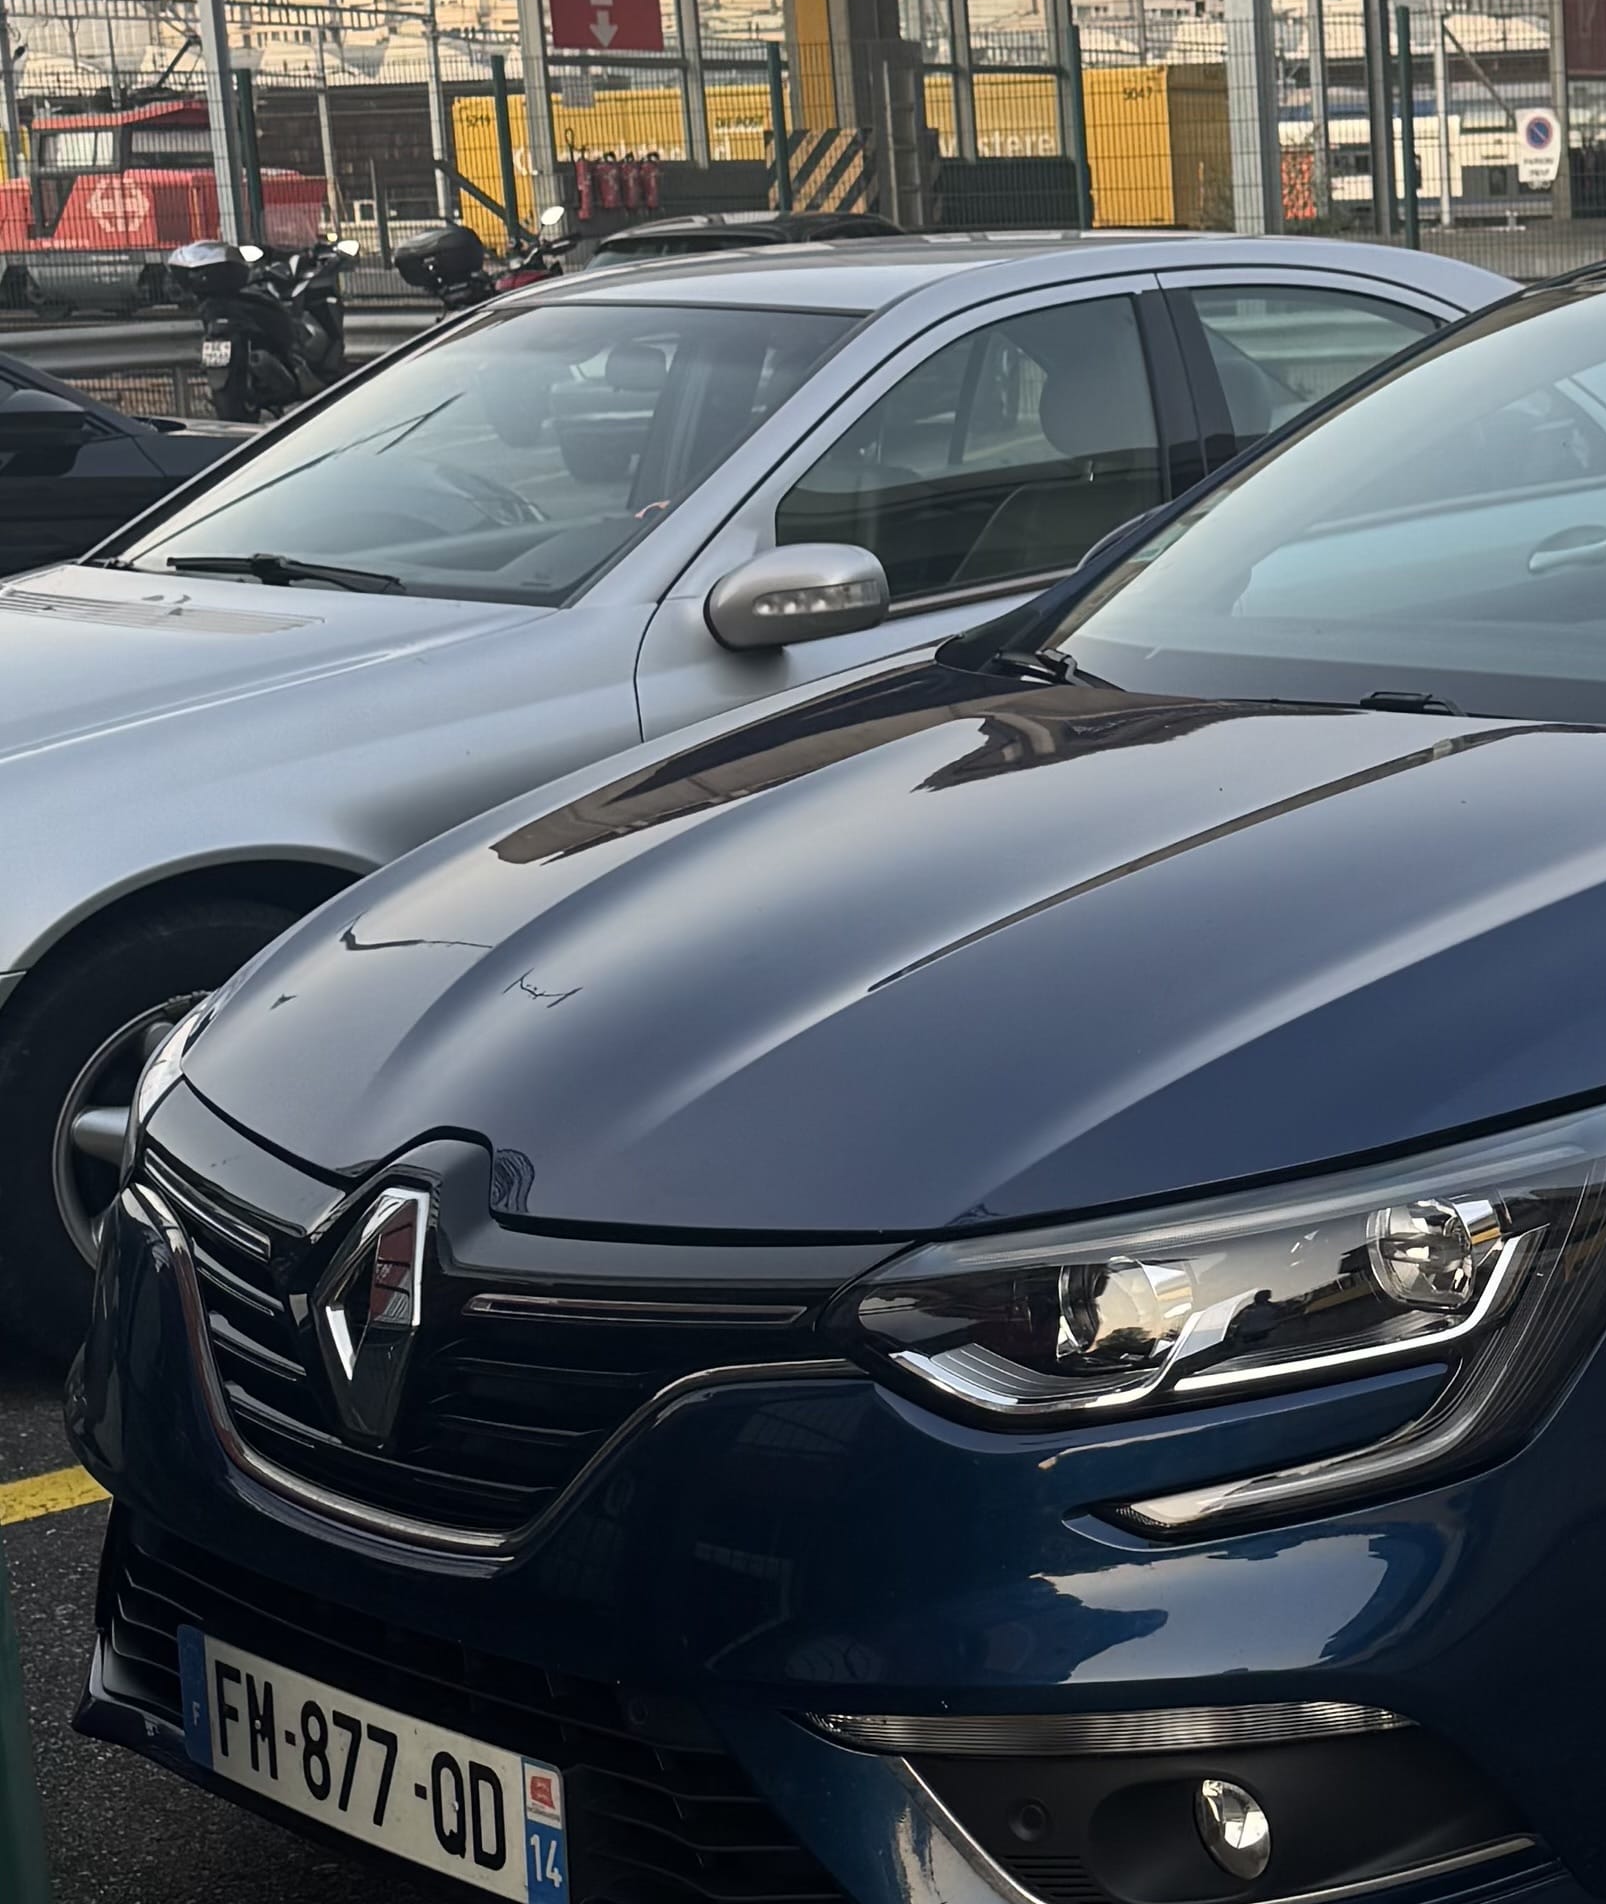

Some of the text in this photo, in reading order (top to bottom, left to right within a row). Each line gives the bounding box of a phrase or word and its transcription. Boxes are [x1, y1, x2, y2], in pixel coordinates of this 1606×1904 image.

[192, 1700, 201, 1727] F
[214, 1659, 507, 1872] FM-877-QD
[530, 1833, 563, 1888] 14
